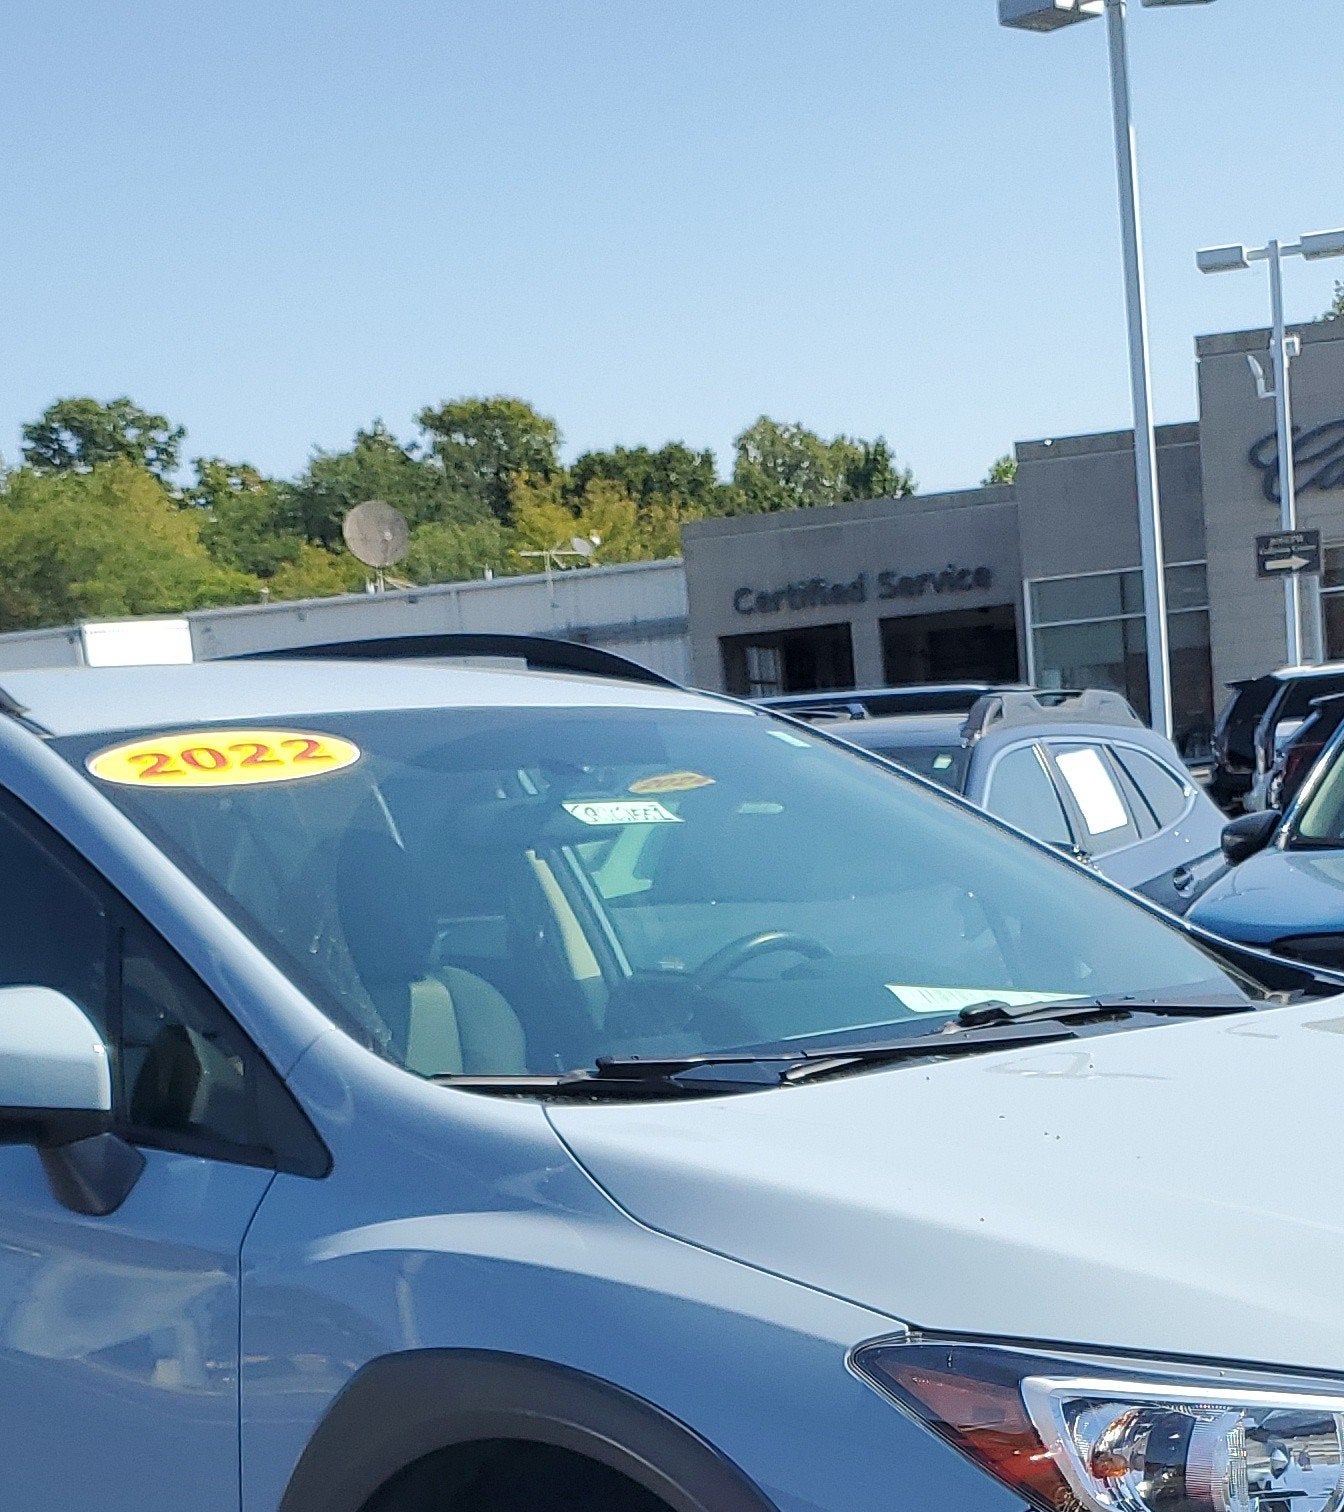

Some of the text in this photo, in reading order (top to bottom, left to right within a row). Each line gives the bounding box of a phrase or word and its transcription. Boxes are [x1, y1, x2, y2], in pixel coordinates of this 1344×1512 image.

[733, 563, 992, 615] Certified Service
[127, 738, 334, 780] 2022
